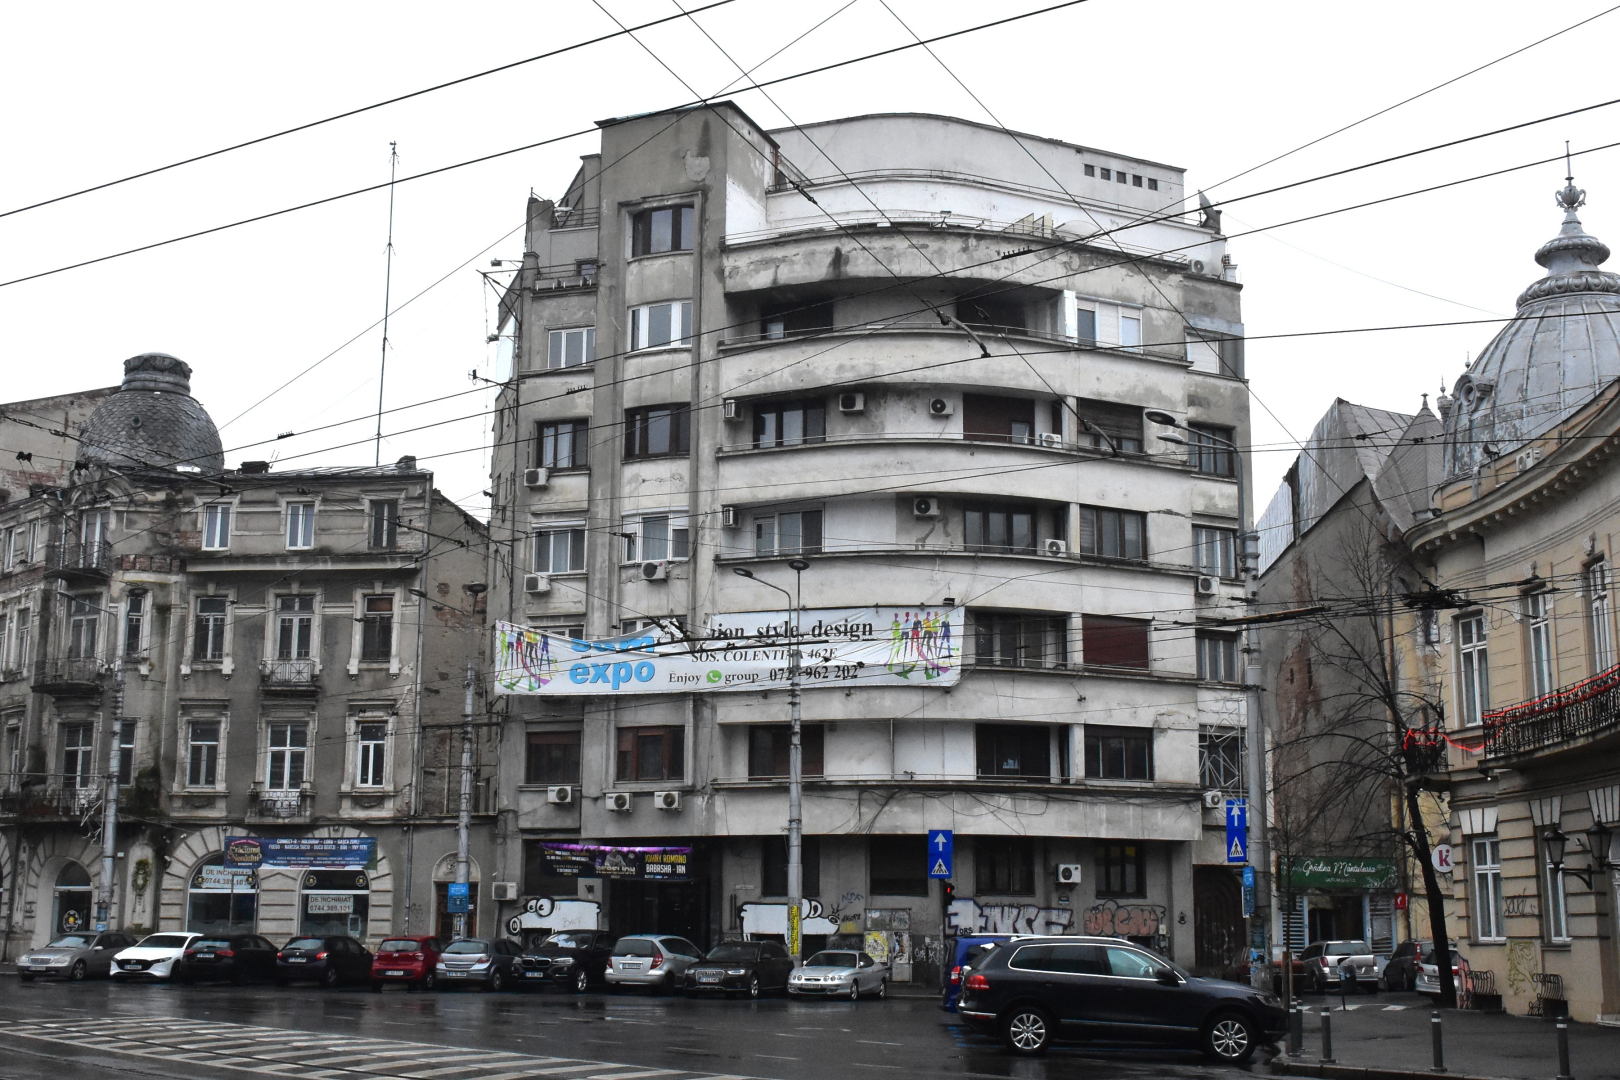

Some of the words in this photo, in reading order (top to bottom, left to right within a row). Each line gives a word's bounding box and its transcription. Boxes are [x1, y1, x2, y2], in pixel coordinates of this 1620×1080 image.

[811, 619, 873, 641] design
[692, 651, 719, 662] SOS.
[723, 649, 804, 661] COLENTI
[569, 661, 655, 690] expo
[669, 672, 702, 685] Enjoy
[724, 672, 759, 684] group
[769, 667, 801, 681] 072
[805, 665, 829, 680] 962
[663, 854, 686, 863] ROMANO
[646, 863, 672, 873] BABASHA
[676, 864, 686, 874] IAN
